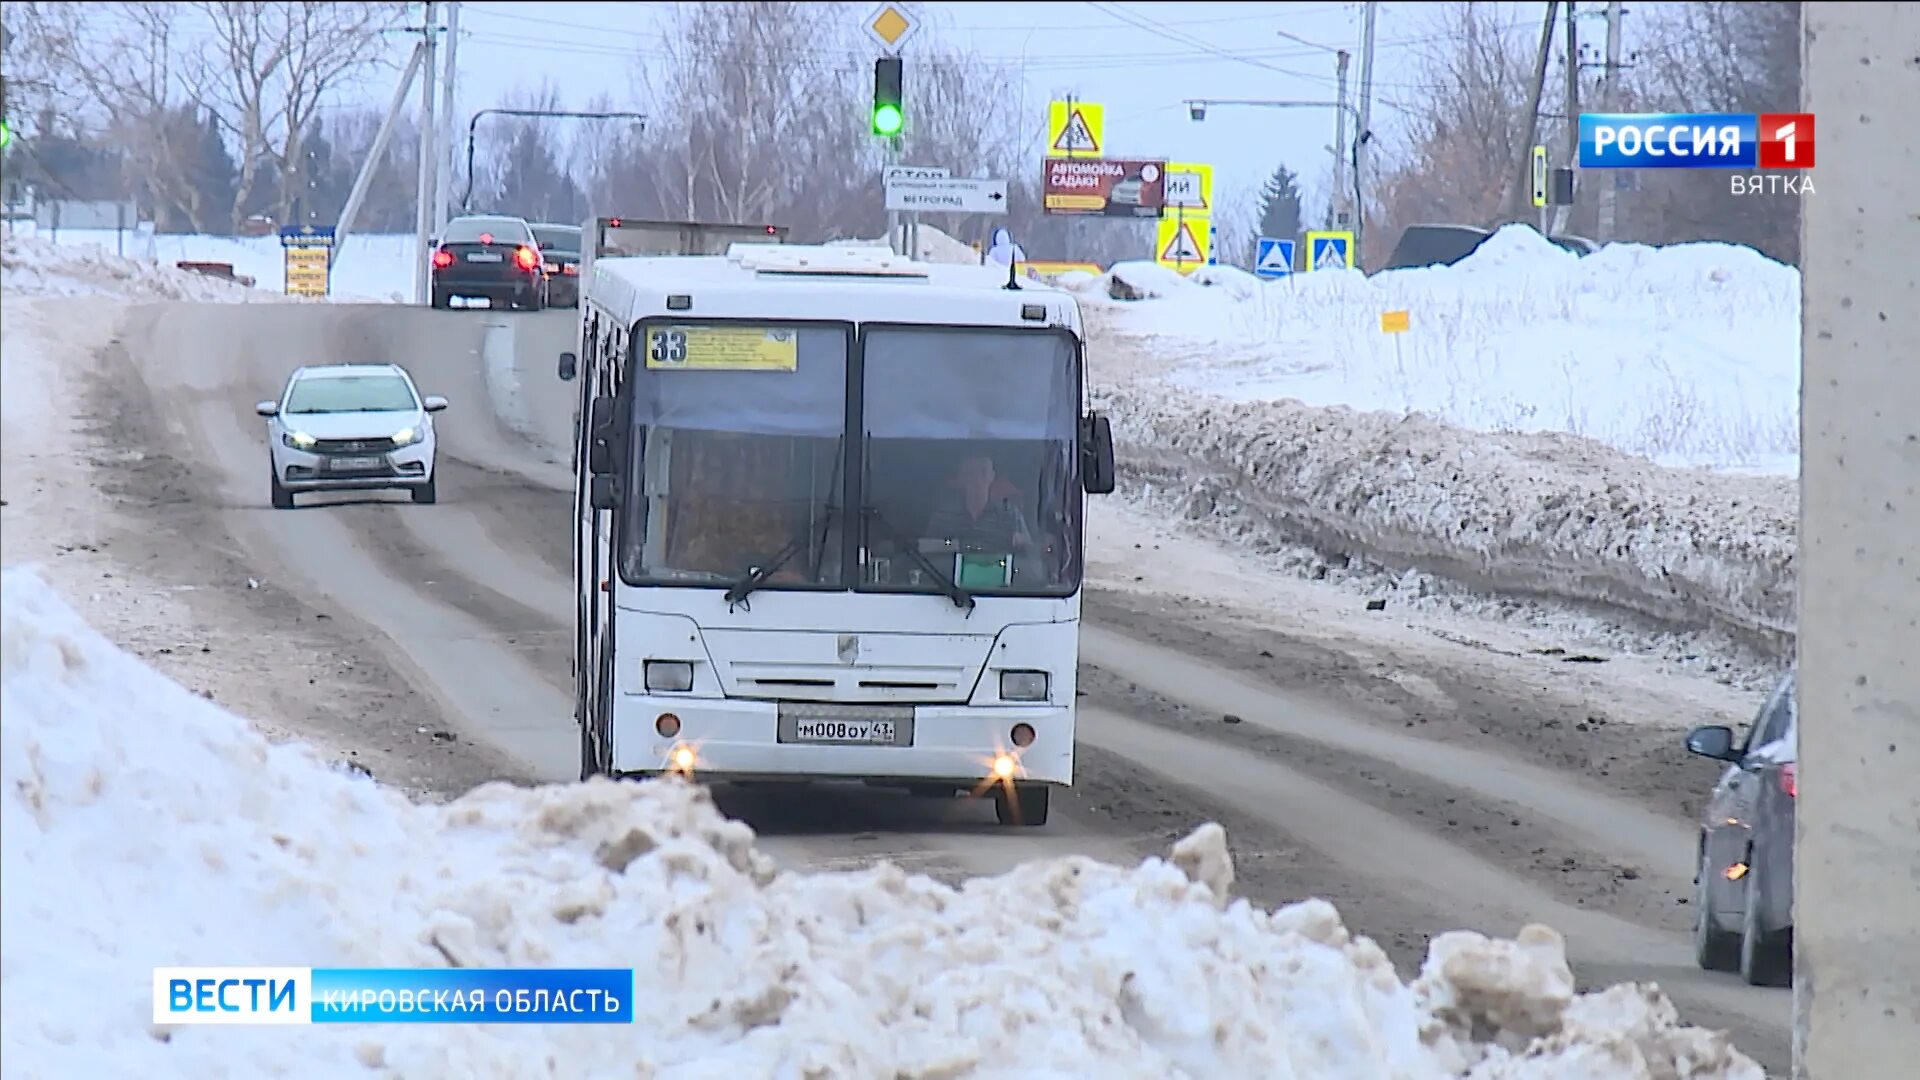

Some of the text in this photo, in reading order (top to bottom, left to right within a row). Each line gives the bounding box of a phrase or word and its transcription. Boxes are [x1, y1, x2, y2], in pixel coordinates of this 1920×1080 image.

[1052, 162, 1124, 175] АВТОМОЙКА
[903, 195, 963, 207] МЕТРОГРАД
[651, 330, 687, 362] 33
[803, 723, 888, 738] М008ОУ 43
